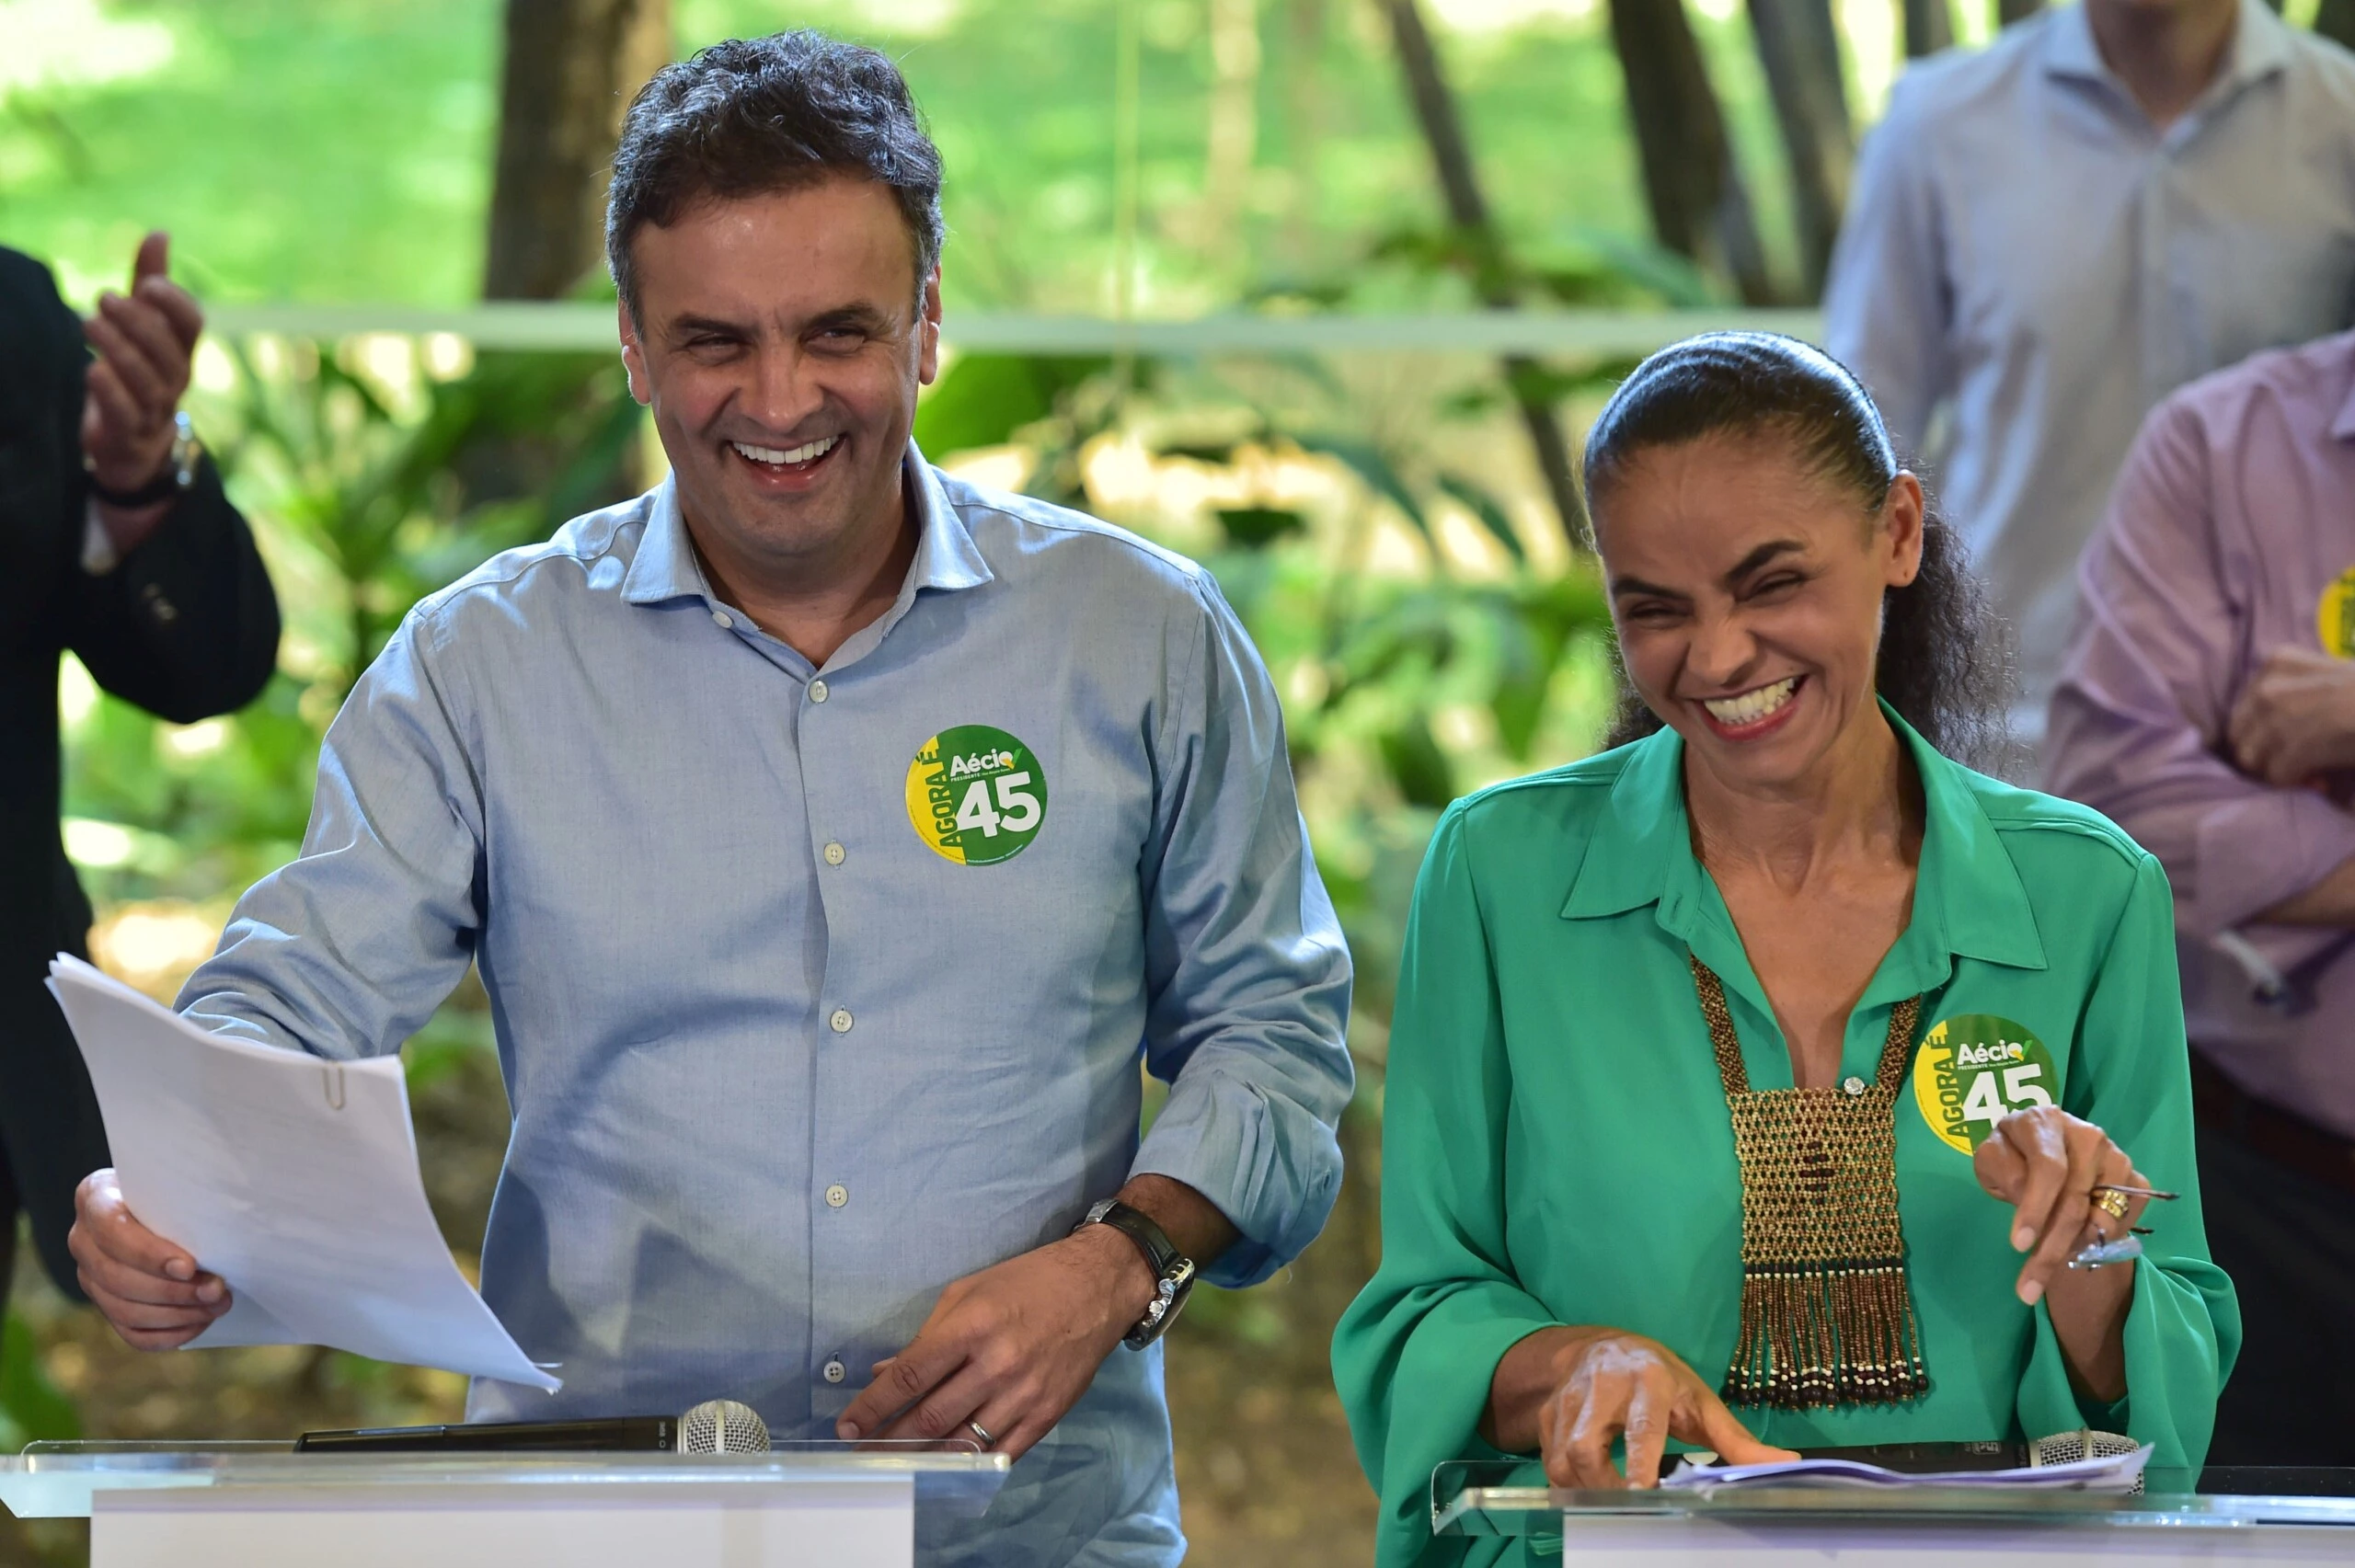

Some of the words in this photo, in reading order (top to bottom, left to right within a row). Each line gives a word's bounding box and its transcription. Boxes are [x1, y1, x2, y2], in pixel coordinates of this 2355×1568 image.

[915, 749, 939, 765] É
[949, 748, 1015, 777] Aécio
[925, 772, 961, 848] AGORA
[955, 771, 1041, 838] 45
[1924, 1034, 1947, 1050] É
[1957, 1039, 2024, 1066] Aécio
[1933, 1059, 1970, 1138] AGORA
[1962, 1063, 2052, 1129] 45
